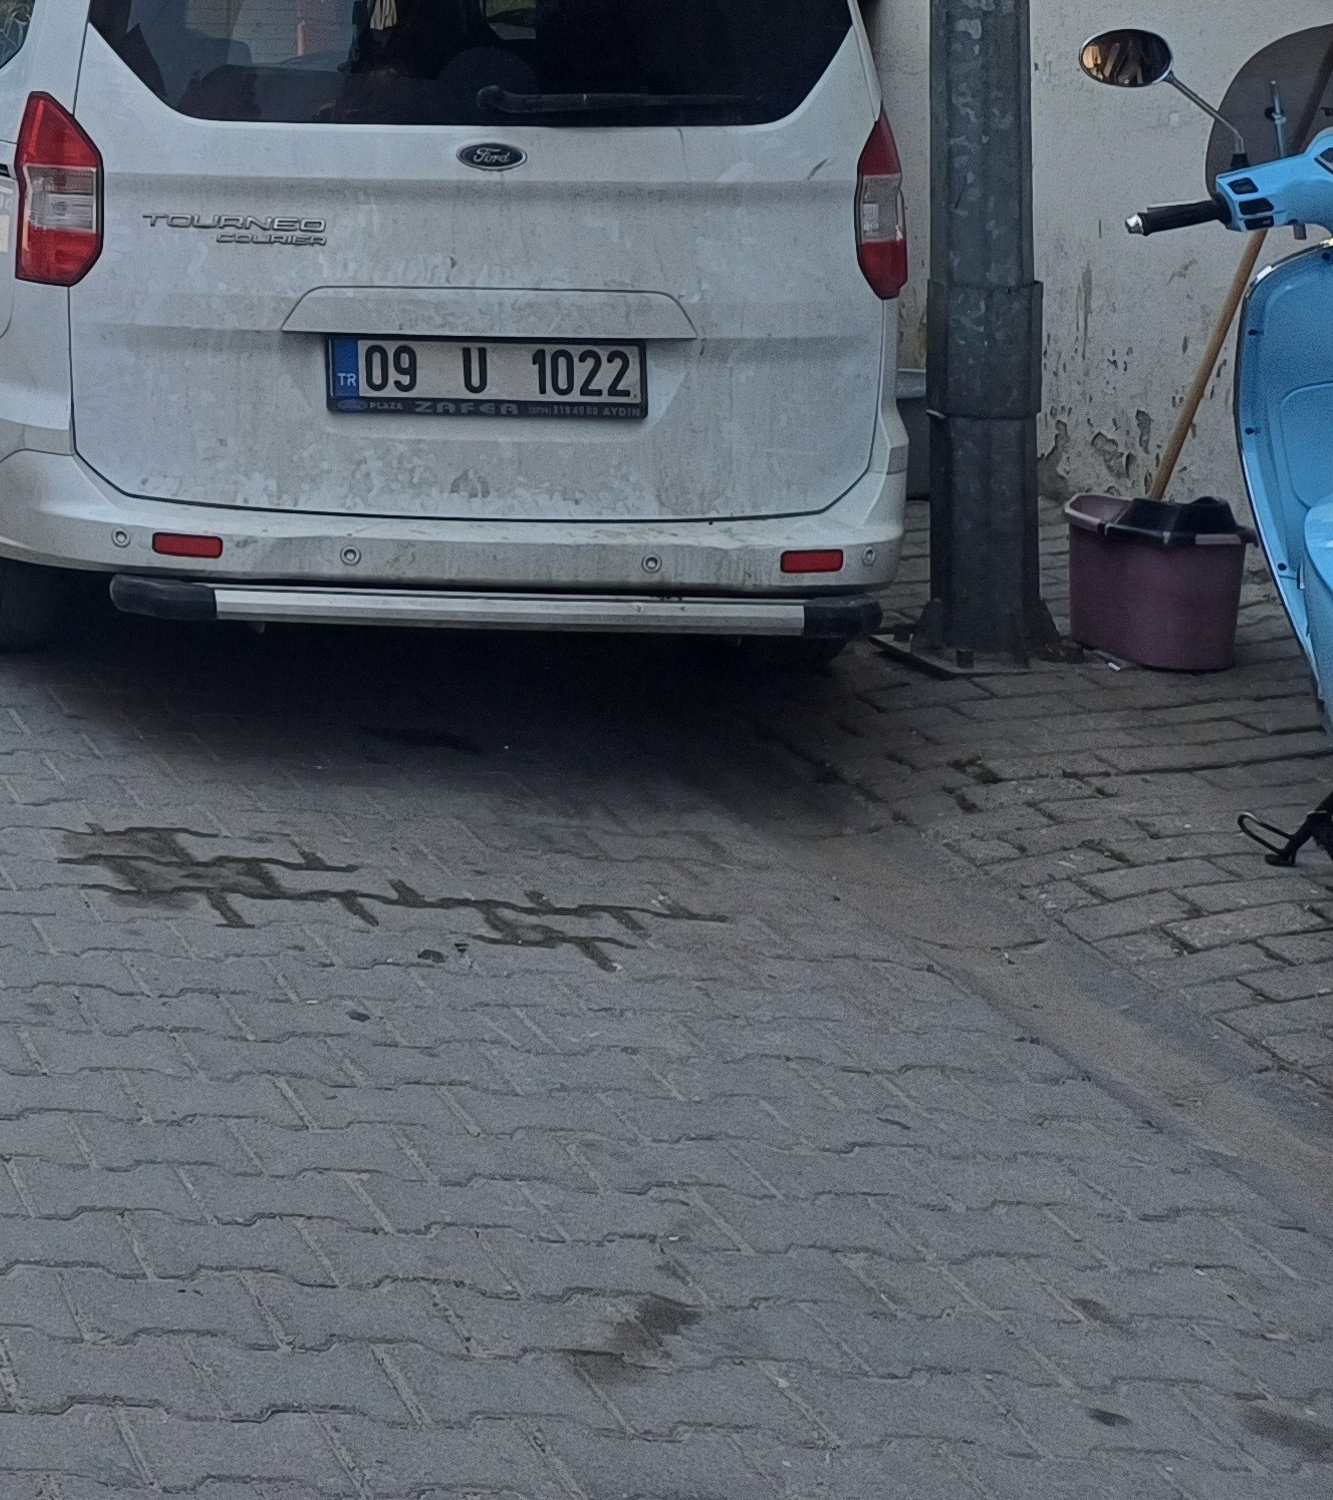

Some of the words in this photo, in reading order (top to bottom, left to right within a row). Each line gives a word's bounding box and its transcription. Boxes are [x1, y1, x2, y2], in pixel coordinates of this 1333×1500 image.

[473, 147, 511, 164] Ford
[143, 212, 327, 233] TOURNEO
[216, 233, 327, 246] COURIER
[337, 372, 357, 387] TR
[365, 344, 417, 393] 09
[461, 346, 487, 394] U
[532, 348, 631, 398] 1022
[414, 400, 519, 416] ZAFER
